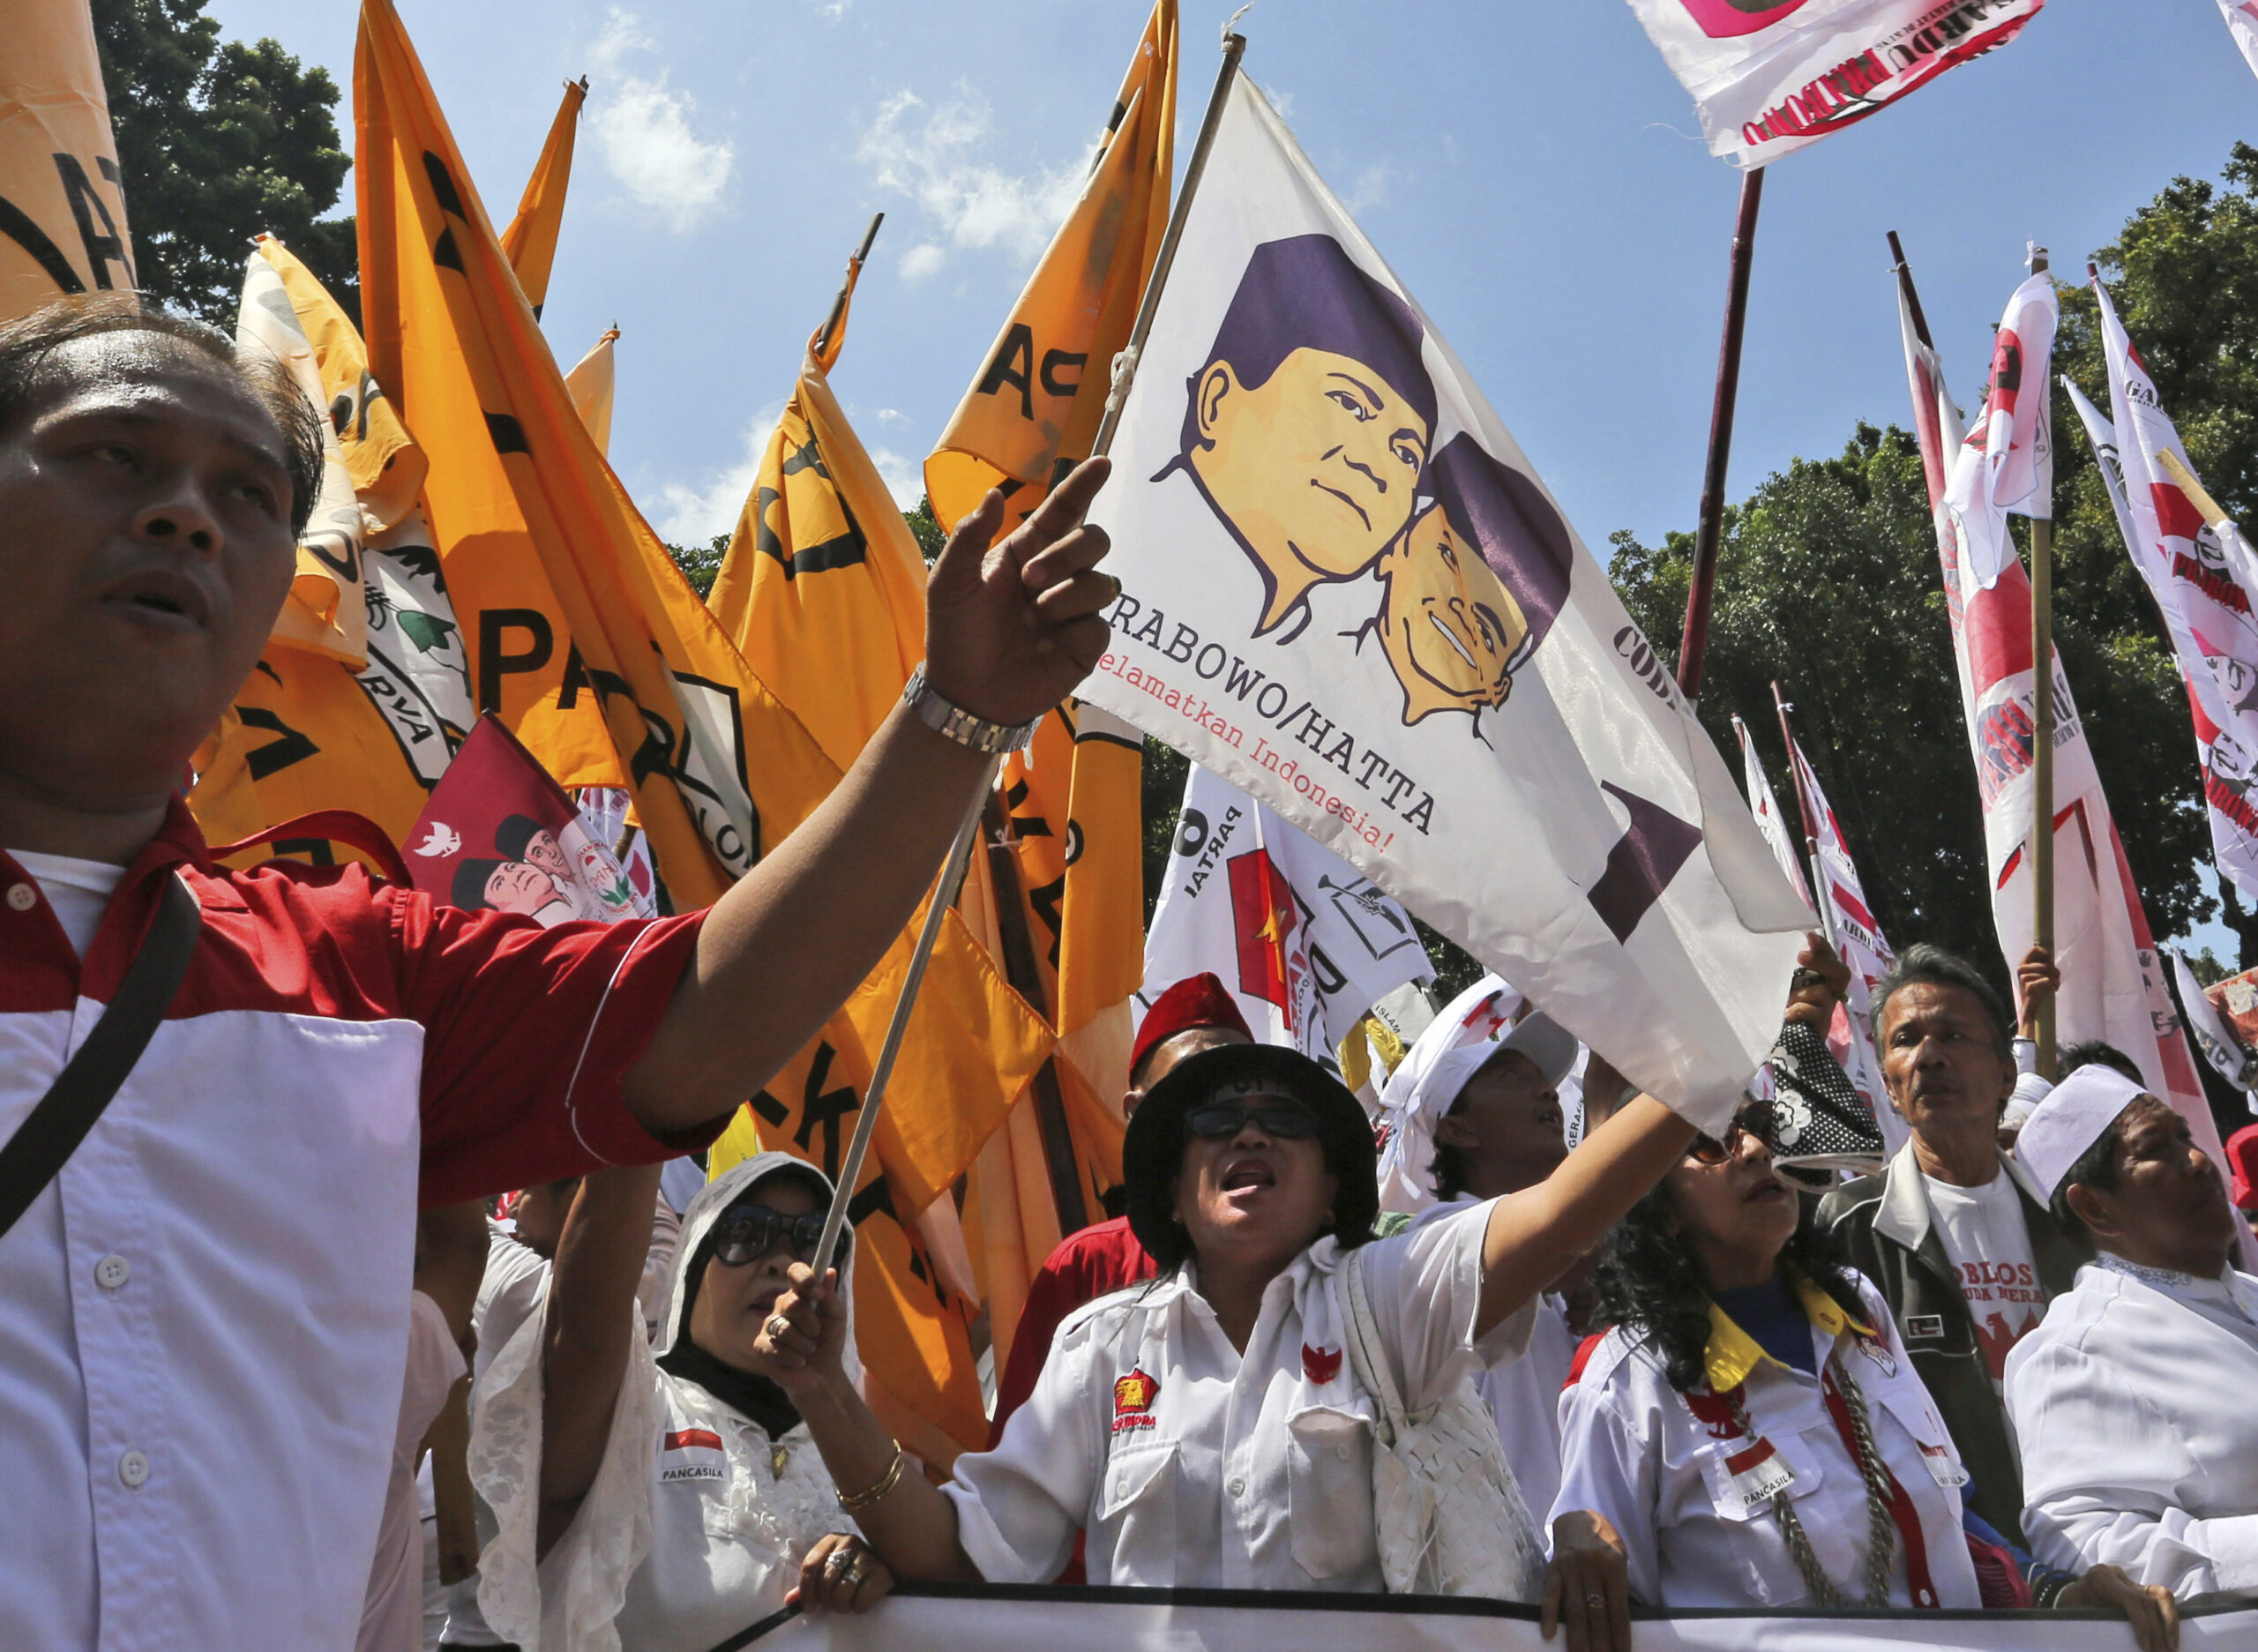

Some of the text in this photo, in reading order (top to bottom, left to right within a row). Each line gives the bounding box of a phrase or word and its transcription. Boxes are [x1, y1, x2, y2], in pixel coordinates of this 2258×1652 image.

[1743, 48, 1894, 146] PRABOWO
[361, 662, 435, 745] RYA
[1109, 593, 1435, 835] RABOWO/HATTA
[1098, 653, 1394, 853] elamatkan Indonesia!
[1375, 1005, 1401, 1035] ISLAM
[662, 1467, 724, 1481] PANCASILA
[1743, 1470, 1795, 1505] PANCASILA
